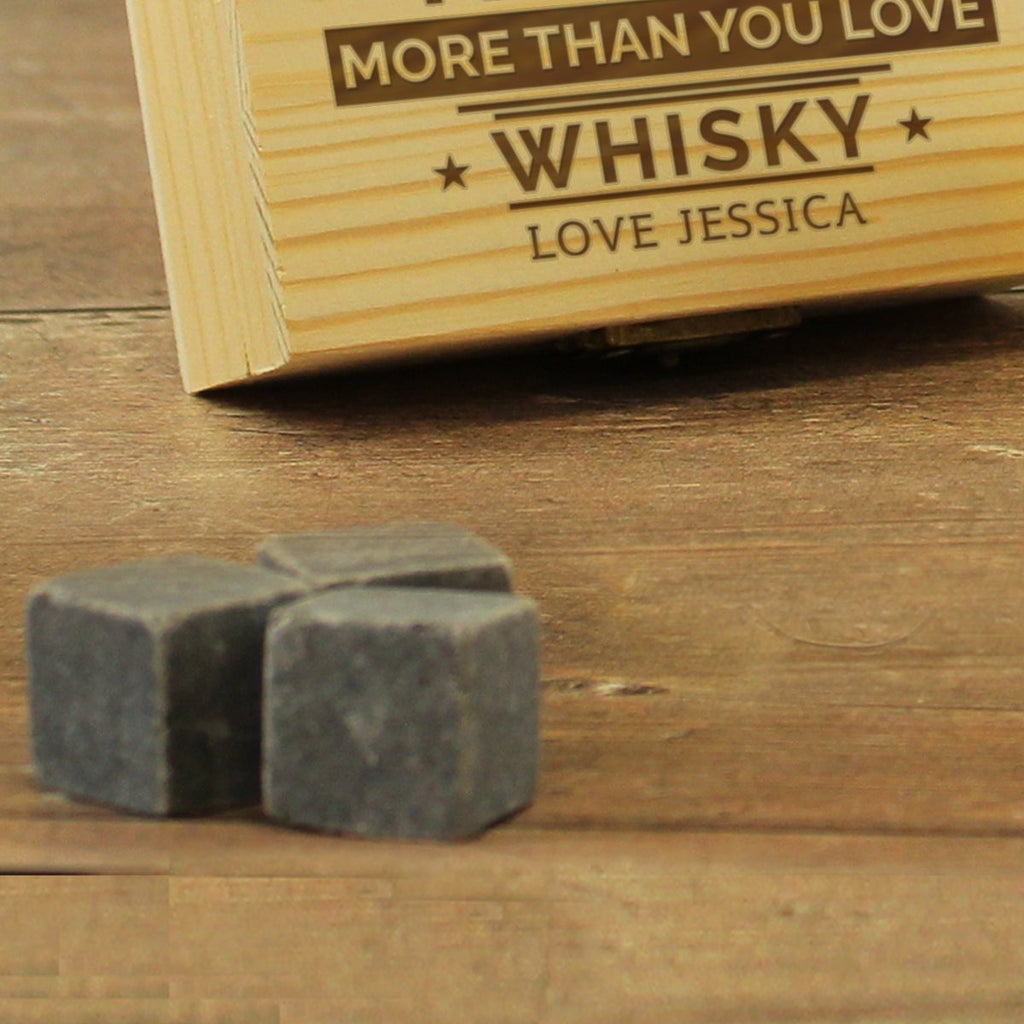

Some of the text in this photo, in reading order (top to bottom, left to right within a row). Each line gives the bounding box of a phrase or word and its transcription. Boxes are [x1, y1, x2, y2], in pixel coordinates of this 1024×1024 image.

[339, 29, 516, 89] MORE
[524, 13, 690, 70] THAN
[701, 0, 823, 53] YOU
[491, 94, 871, 192] WHISKY
[527, 192, 867, 261] LOVE JESSICA
